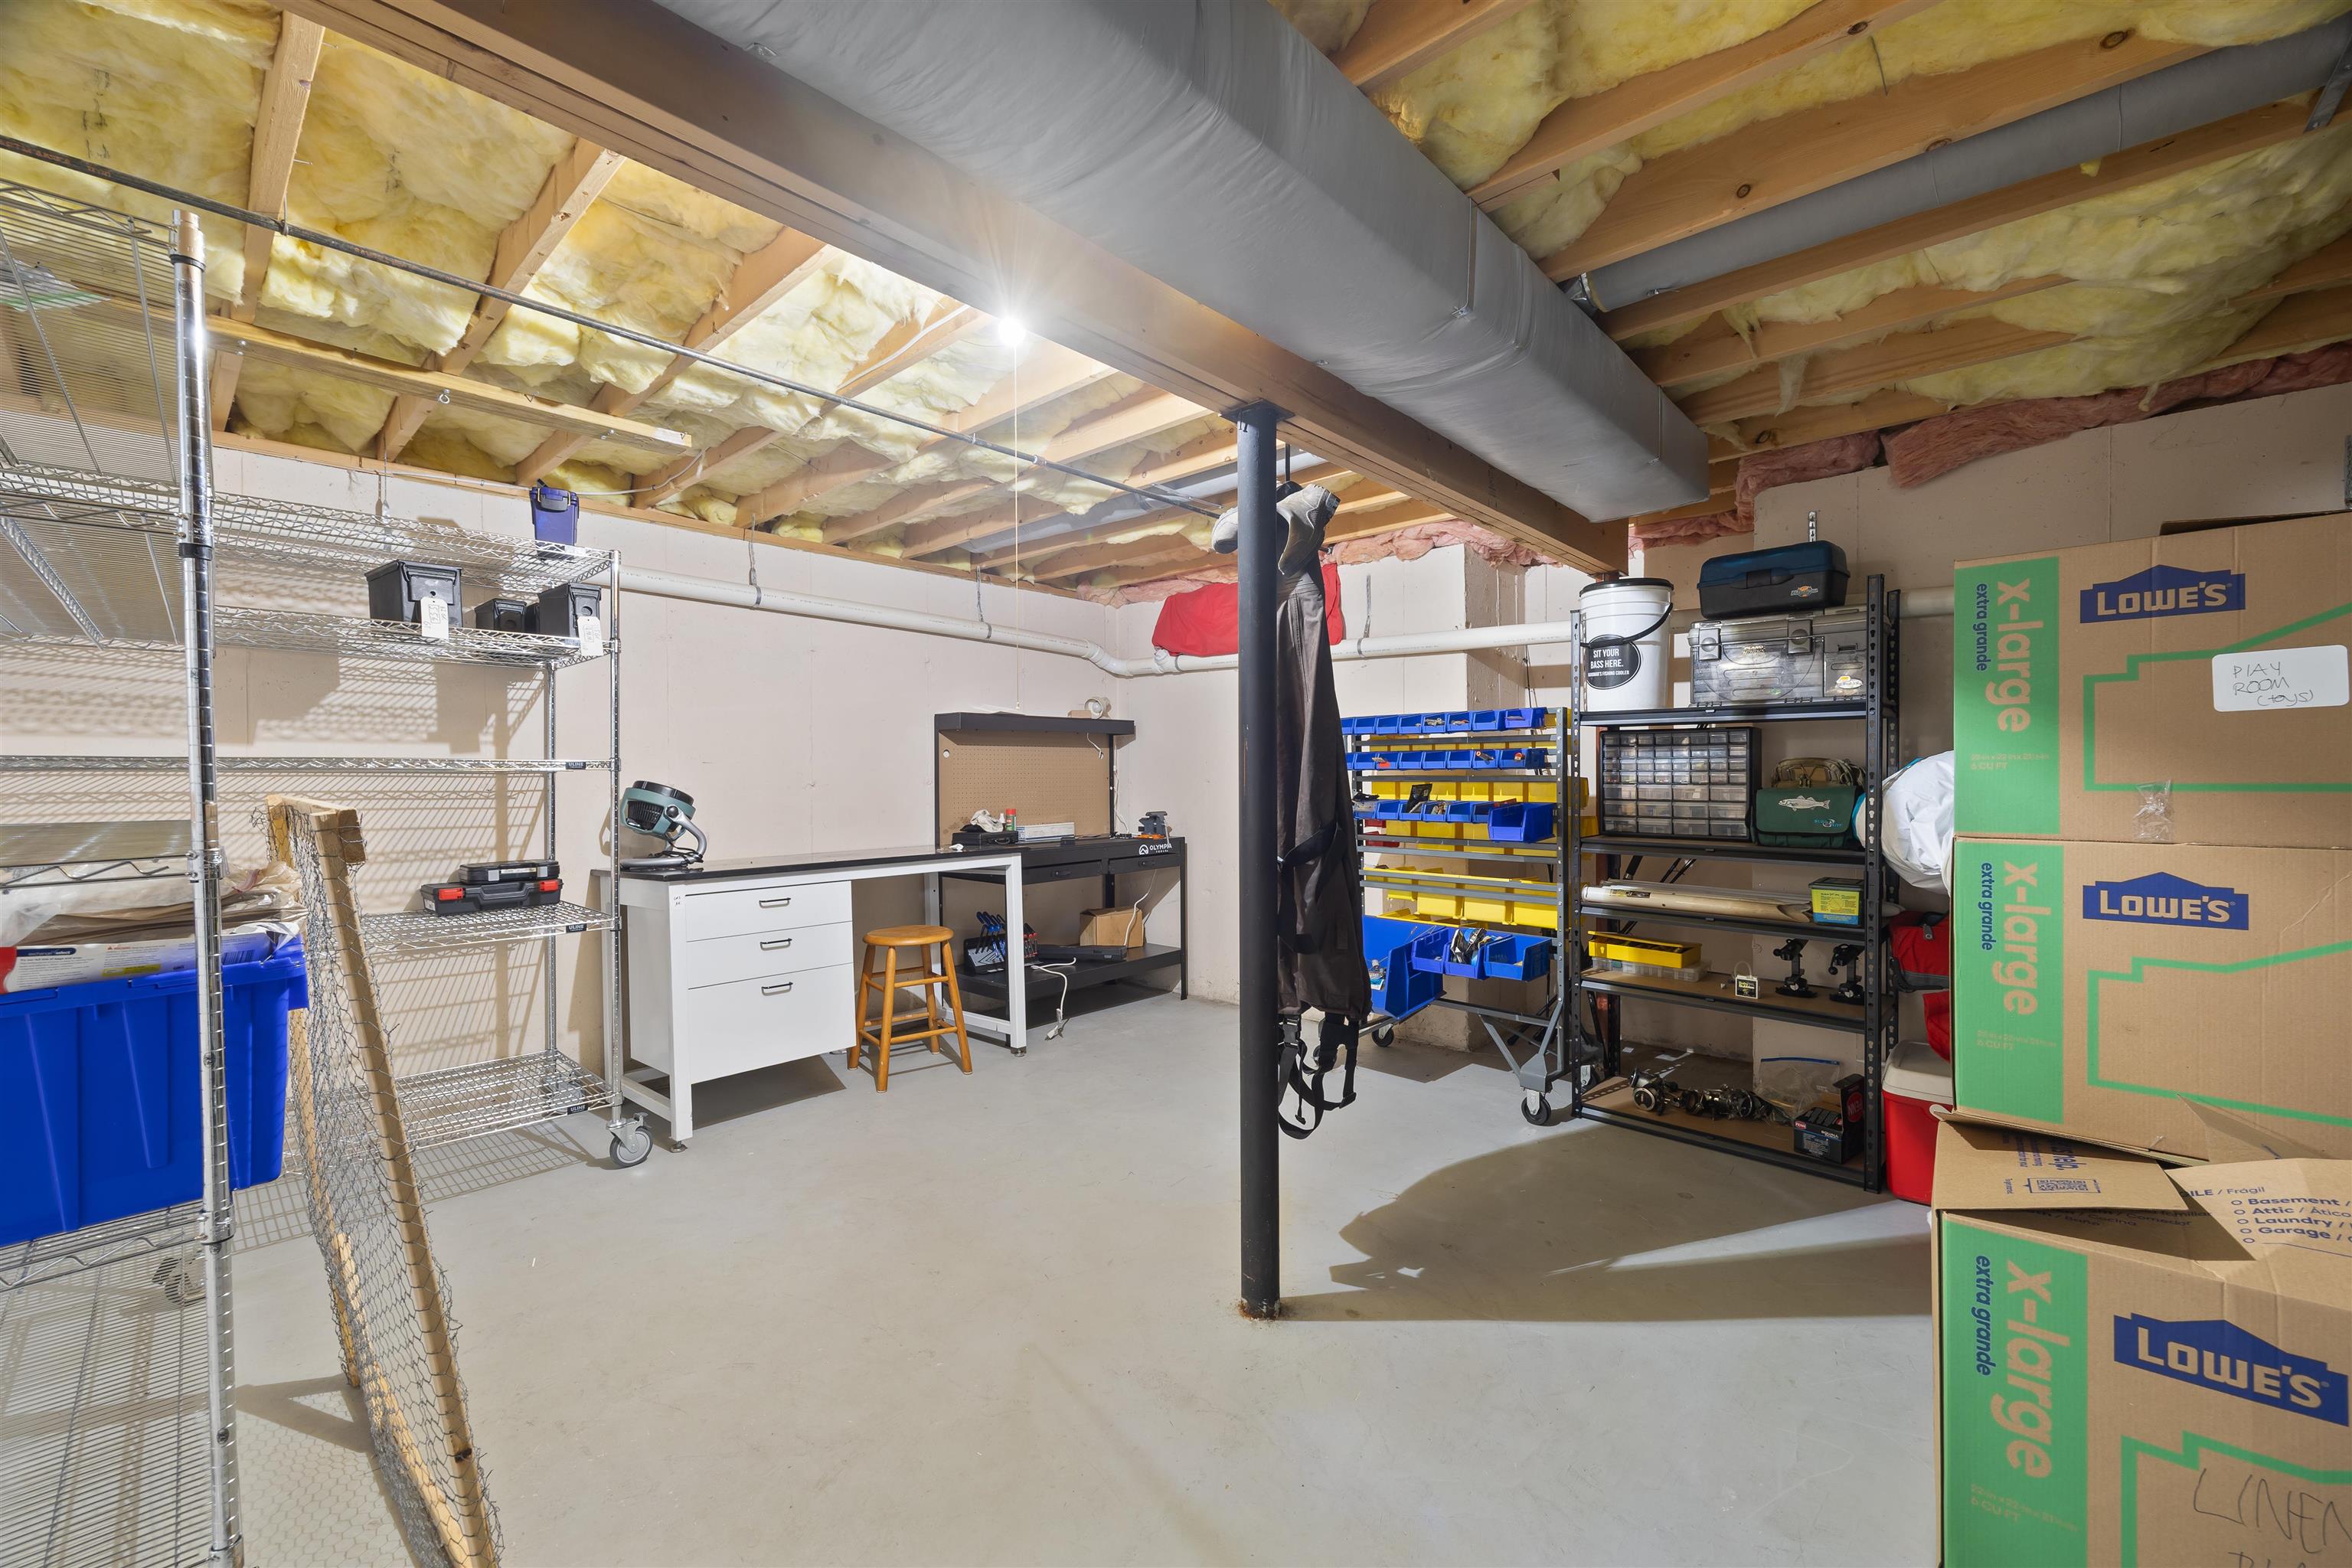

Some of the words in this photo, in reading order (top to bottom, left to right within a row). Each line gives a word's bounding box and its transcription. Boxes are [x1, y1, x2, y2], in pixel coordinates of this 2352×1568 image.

[1975, 583, 1988, 619] extra
[1590, 660, 1604, 669] BASS
[1605, 658, 1624, 668] HERE.
[1592, 649, 1602, 658] SIT
[1602, 648, 1619, 658] YOUR
[1973, 622, 1991, 671] grande
[1984, 578, 2044, 733] x-large
[2233, 677, 2289, 696] ROOM
[1981, 862, 1994, 899] extra
[1978, 901, 1996, 951] grande
[1992, 861, 2051, 1015] x-large
[2226, 1187, 2265, 1195] Frágil
[2248, 1197, 2340, 1207] Basement
[2252, 1206, 2295, 1215] Attic
[2255, 1217, 2333, 1228] Laundry
[2259, 1227, 2331, 1239] Garage
[1975, 1255, 1994, 1306] extra
[1971, 1306, 1997, 1377] grande
[1991, 1258, 2070, 1478] x-large
